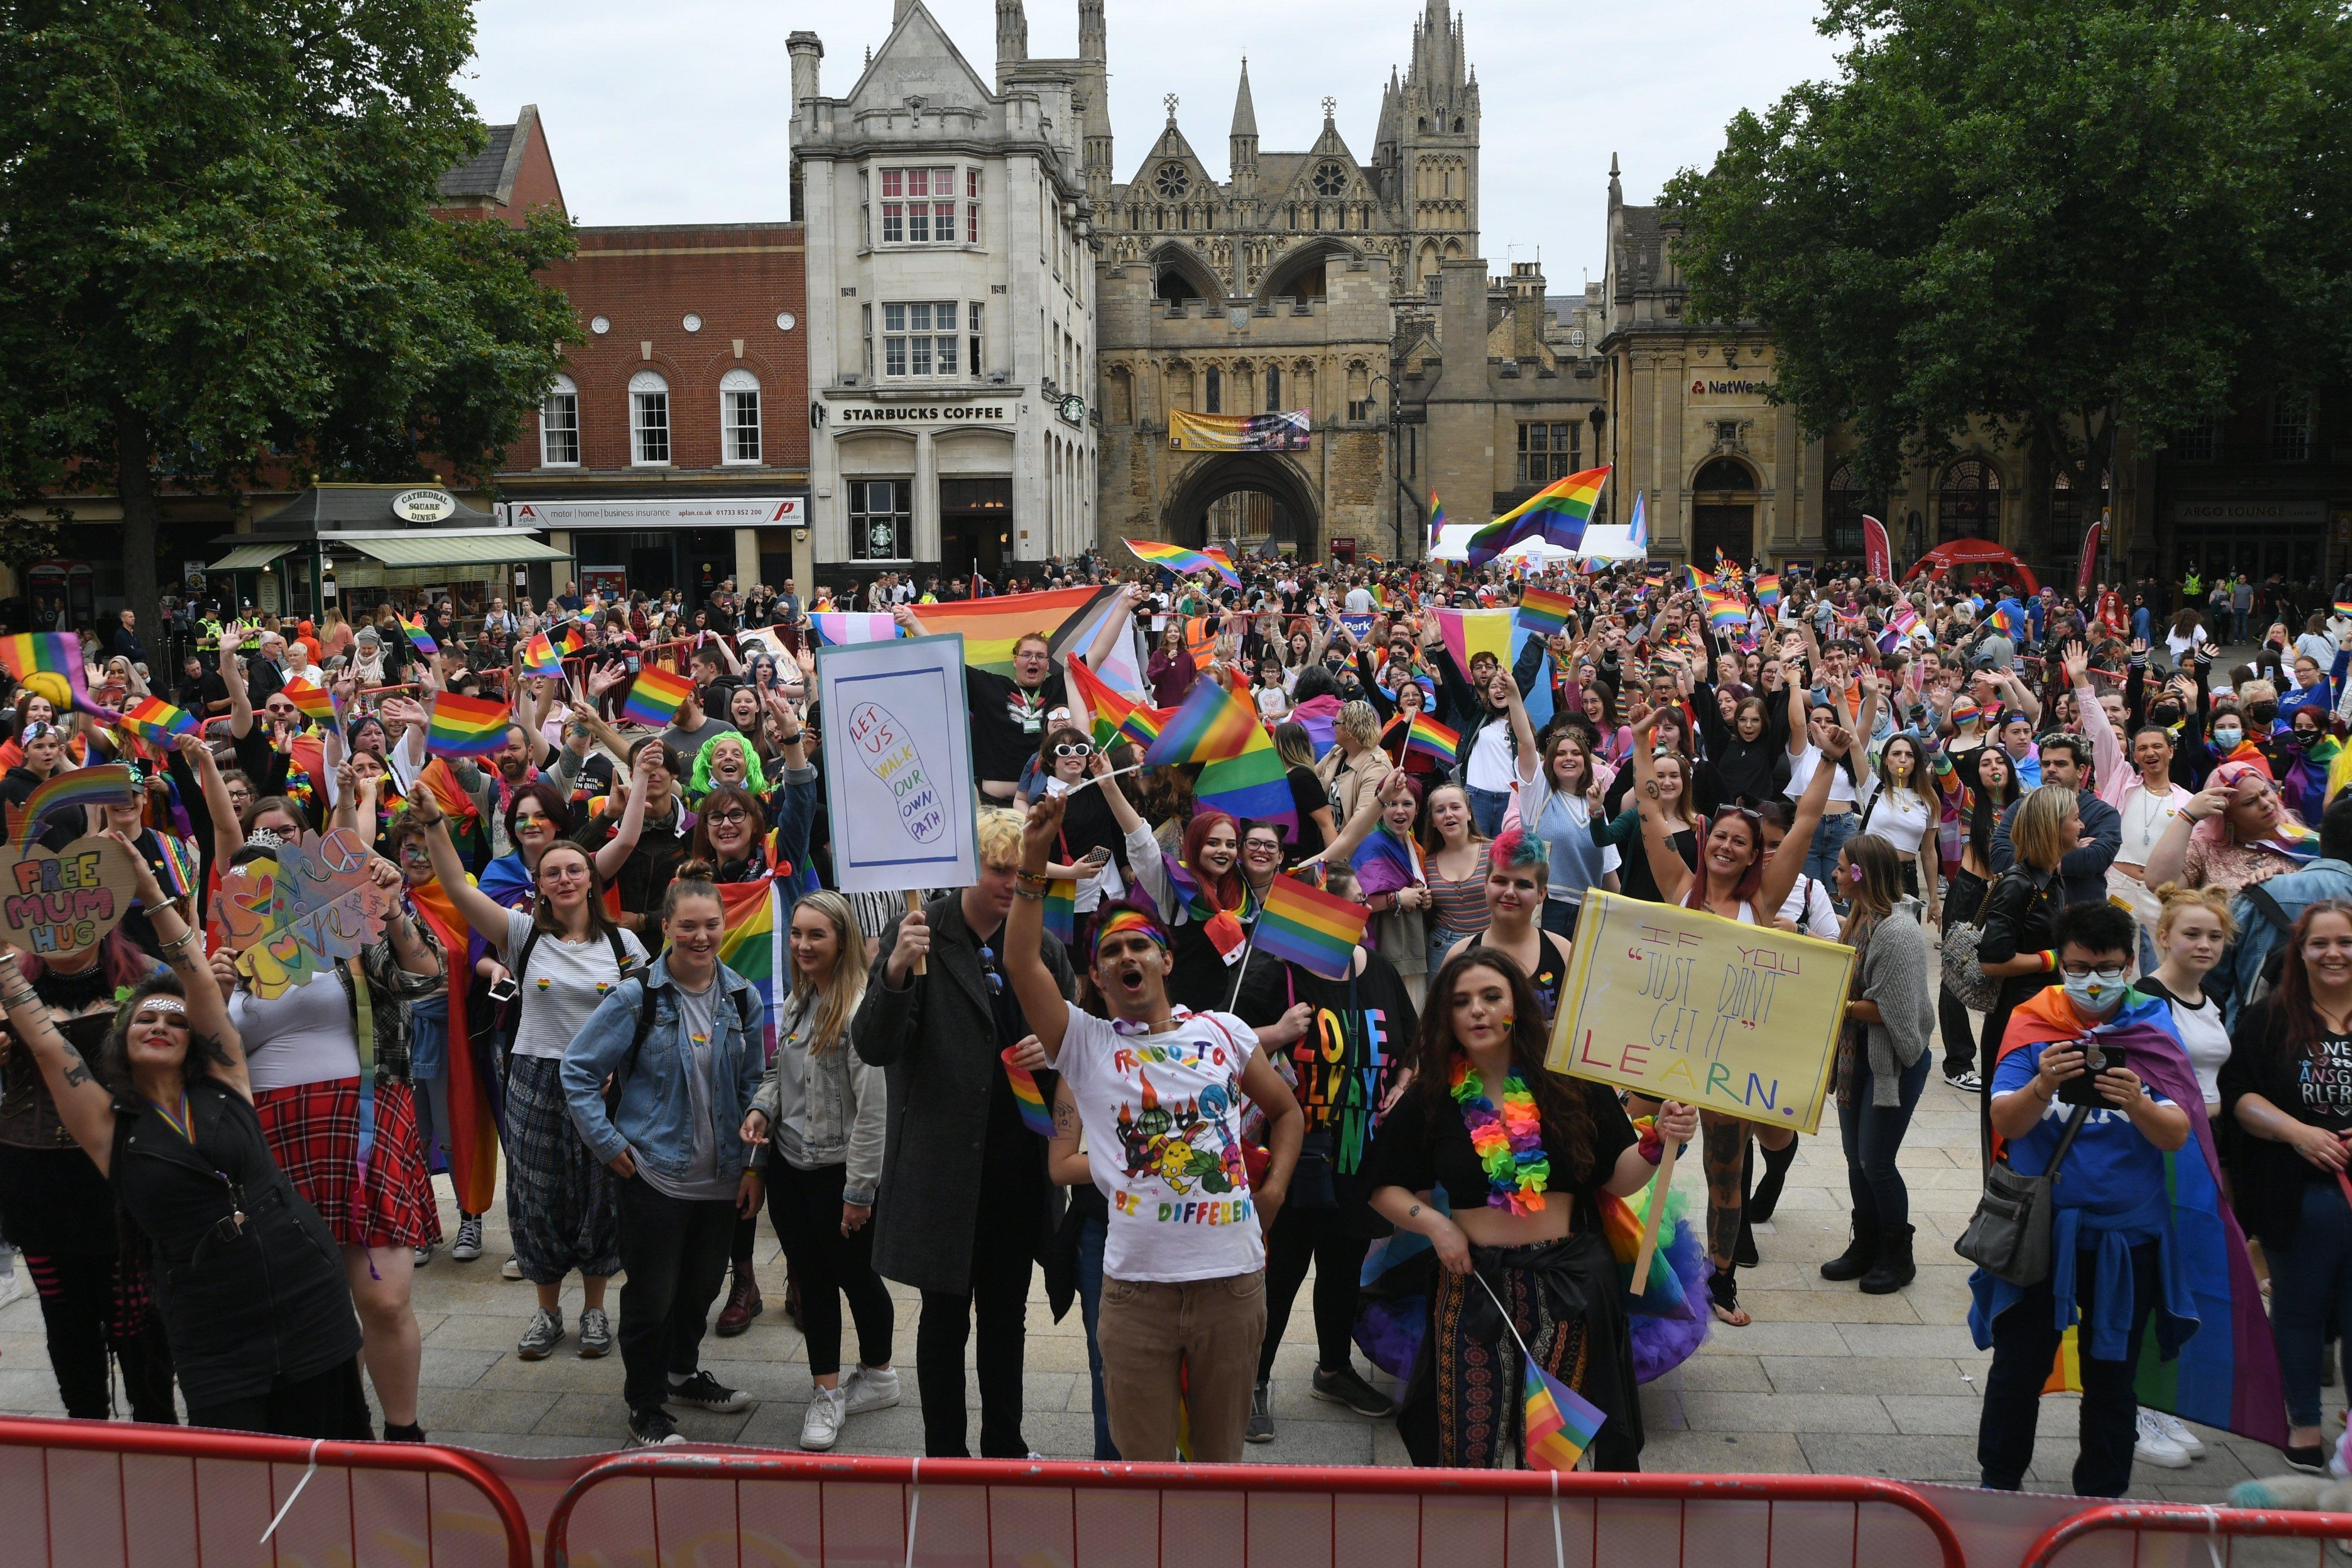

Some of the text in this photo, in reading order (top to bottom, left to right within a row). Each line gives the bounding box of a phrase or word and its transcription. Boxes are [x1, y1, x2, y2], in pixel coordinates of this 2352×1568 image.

[843, 407, 1003, 420] STARBUCKS COFFEE
[402, 491, 448, 505] CATHEDRAL
[604, 509, 634, 517] business
[636, 508, 670, 516] insurance
[2184, 507, 2223, 516] ARGO
[2228, 506, 2285, 516] LOUNGE
[851, 706, 878, 741] LET
[865, 724, 893, 753] US
[875, 744, 913, 780] WALK
[894, 769, 924, 797] OUR
[903, 790, 932, 817] OWN
[911, 810, 941, 840] PATH
[12, 850, 101, 894] FREE
[6, 888, 114, 929] MUM
[29, 921, 96, 954] HUG
[1641, 925, 1800, 975] IF YOU
[1293, 1007, 1389, 1067] LOVE
[1650, 1003, 1699, 1054] GET
[1114, 1040, 1226, 1073] ROAD TO
[1581, 1029, 1794, 1116] LEARN.
[1116, 1190, 1142, 1217] BE
